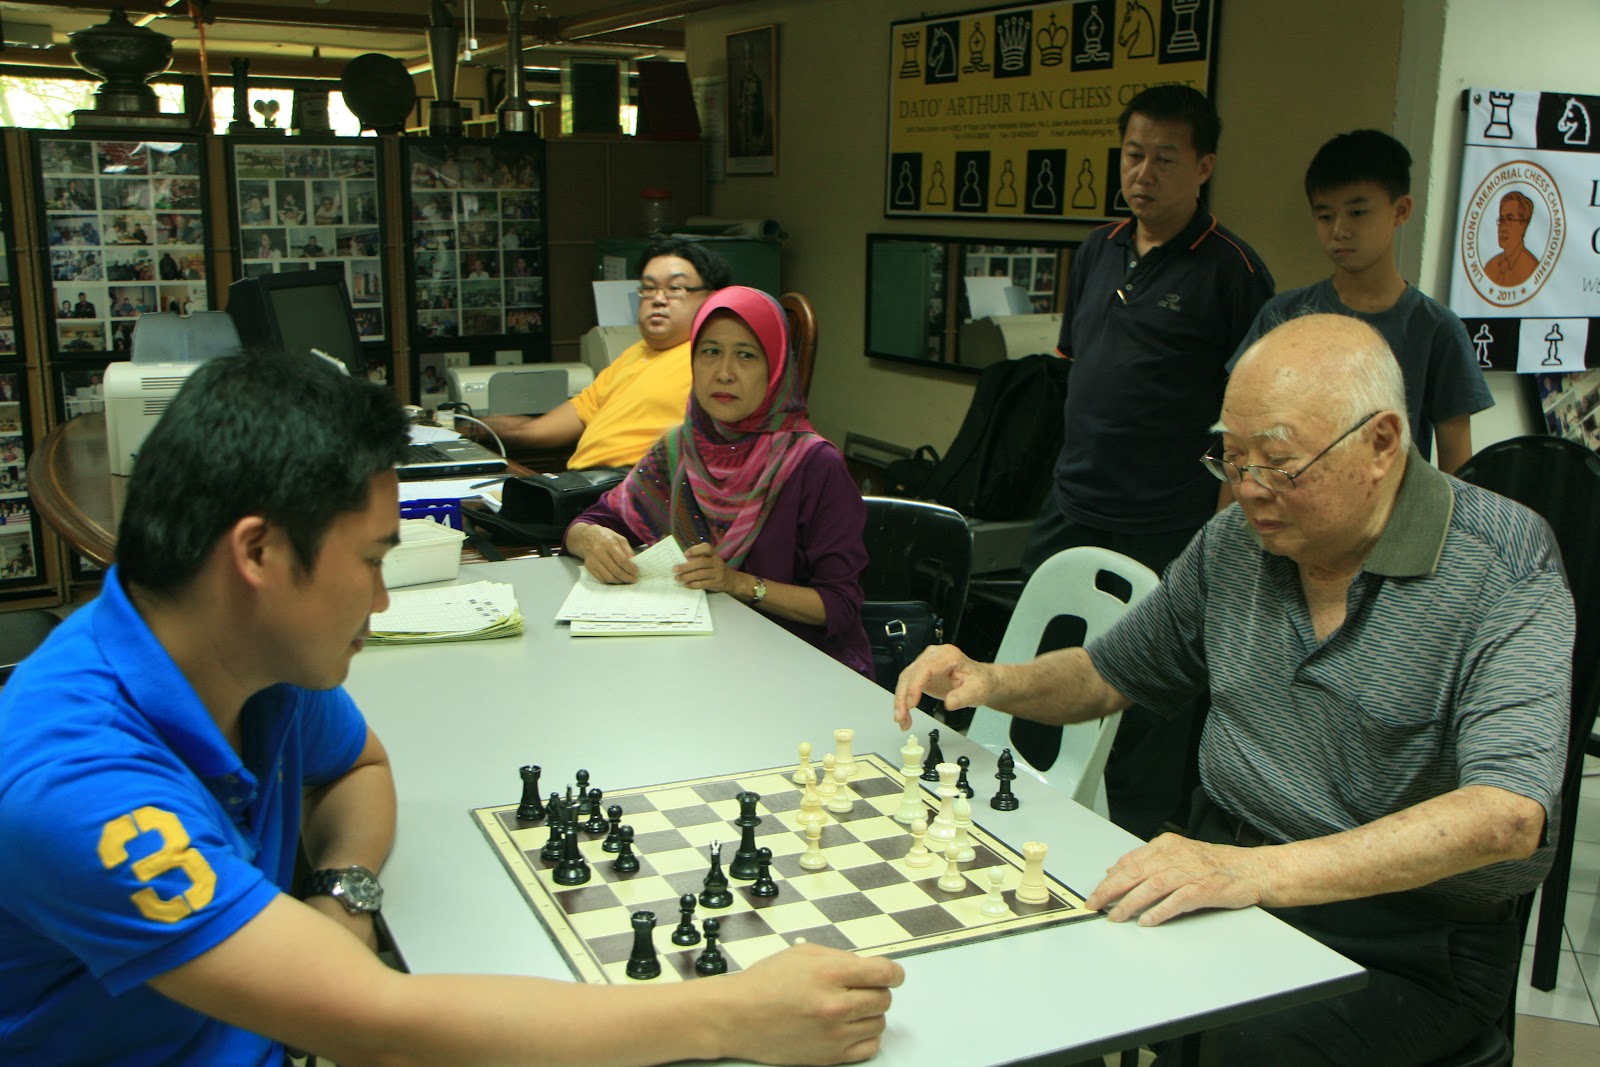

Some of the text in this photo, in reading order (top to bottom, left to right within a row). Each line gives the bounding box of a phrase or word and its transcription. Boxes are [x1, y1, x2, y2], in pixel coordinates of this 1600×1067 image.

[898, 98, 942, 119] DATO'
[946, 93, 1012, 116] ARTHUR
[1018, 90, 1053, 112] TAN
[1059, 85, 1111, 110] CHESS
[1466, 168, 1561, 285] LIM CHONG MEMORIAL CHESS CHAMPIONSHIP
[1496, 290, 1517, 301] 2011
[97, 805, 218, 924] 3
